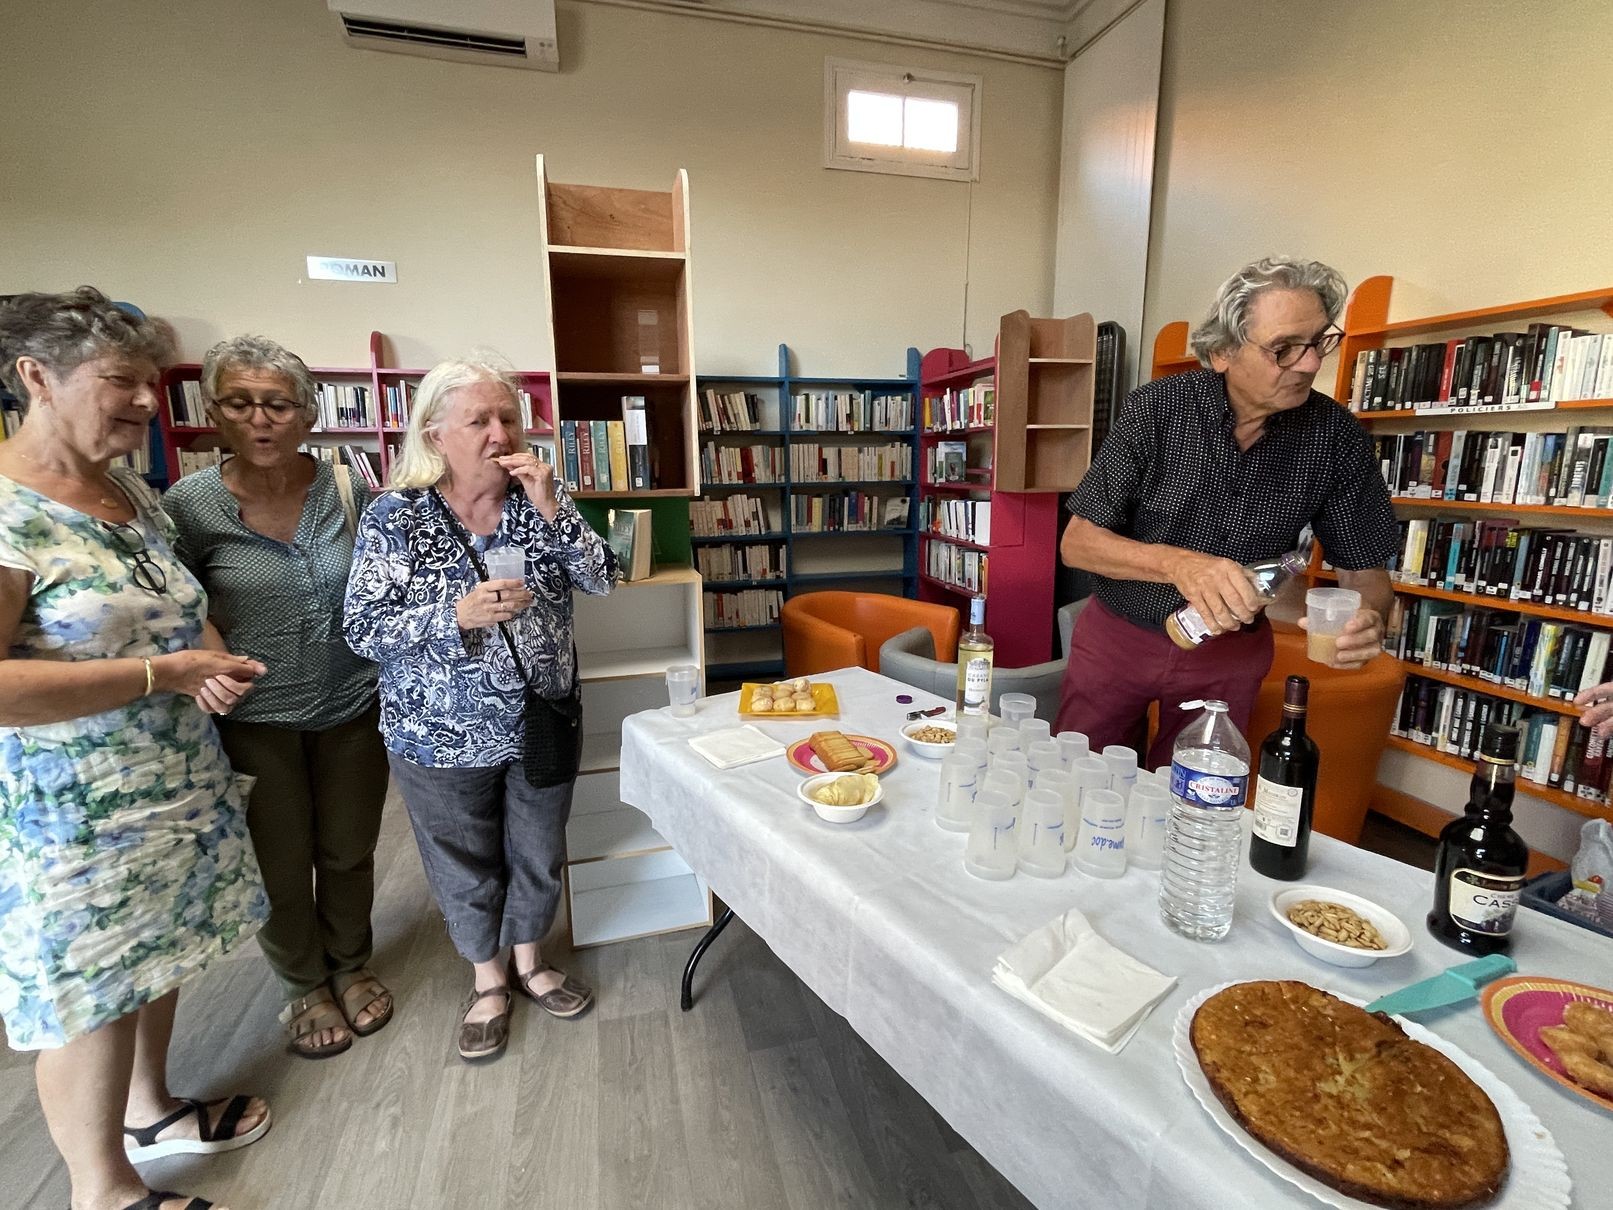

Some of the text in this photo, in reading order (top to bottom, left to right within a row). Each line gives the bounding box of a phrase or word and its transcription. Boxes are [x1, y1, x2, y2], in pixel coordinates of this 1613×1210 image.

[320, 262, 386, 278] OMAN
[1450, 405, 1511, 413] POLICIERS
[568, 432, 576, 455] RILEY
[582, 432, 590, 455] RILEY
[1586, 727, 1597, 759] GIACOMETT
[1190, 781, 1238, 794] CRISTALINE
